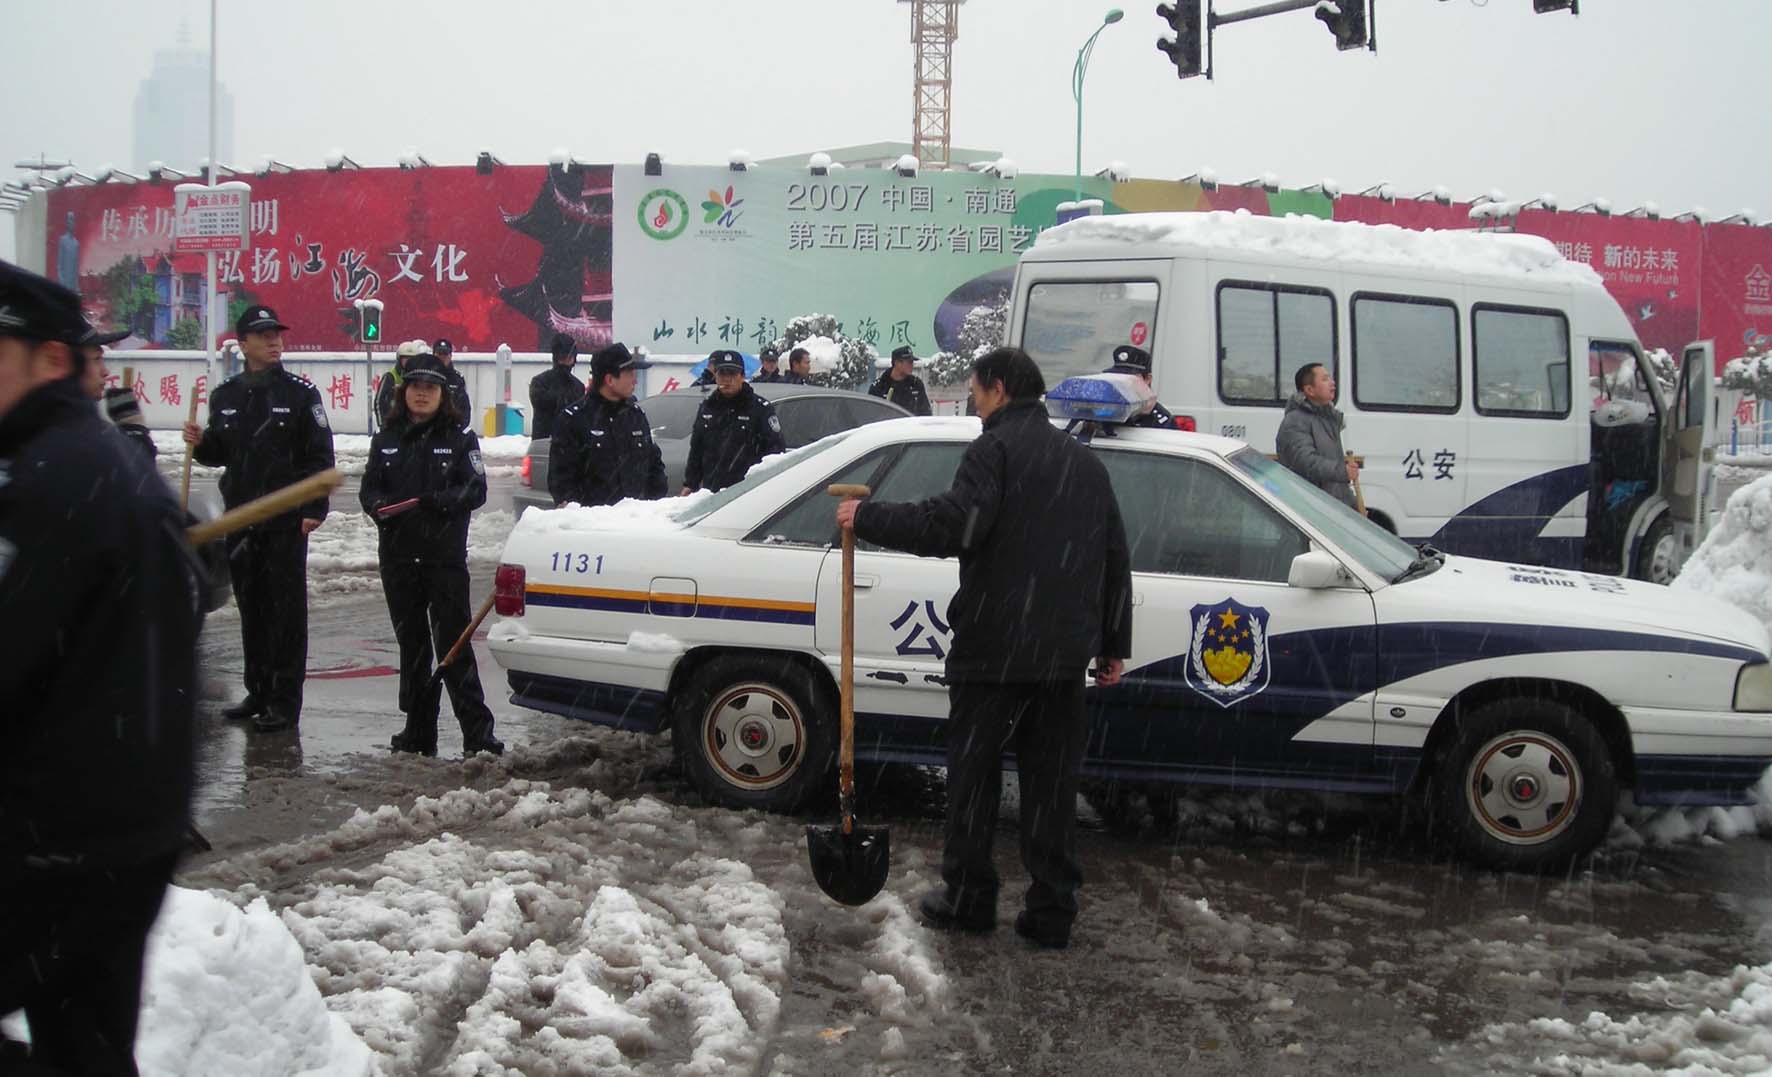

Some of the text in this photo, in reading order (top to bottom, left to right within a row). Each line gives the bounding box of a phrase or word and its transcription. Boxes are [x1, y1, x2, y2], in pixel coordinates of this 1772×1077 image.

[787, 184, 869, 212] 2007
[788, 221, 1046, 255] 第五届江苏省园艺
[1603, 244, 1679, 271] 新的未来
[1402, 448, 1456, 481] 公安
[552, 551, 604, 575] 1131
[889, 599, 950, 661] 公
